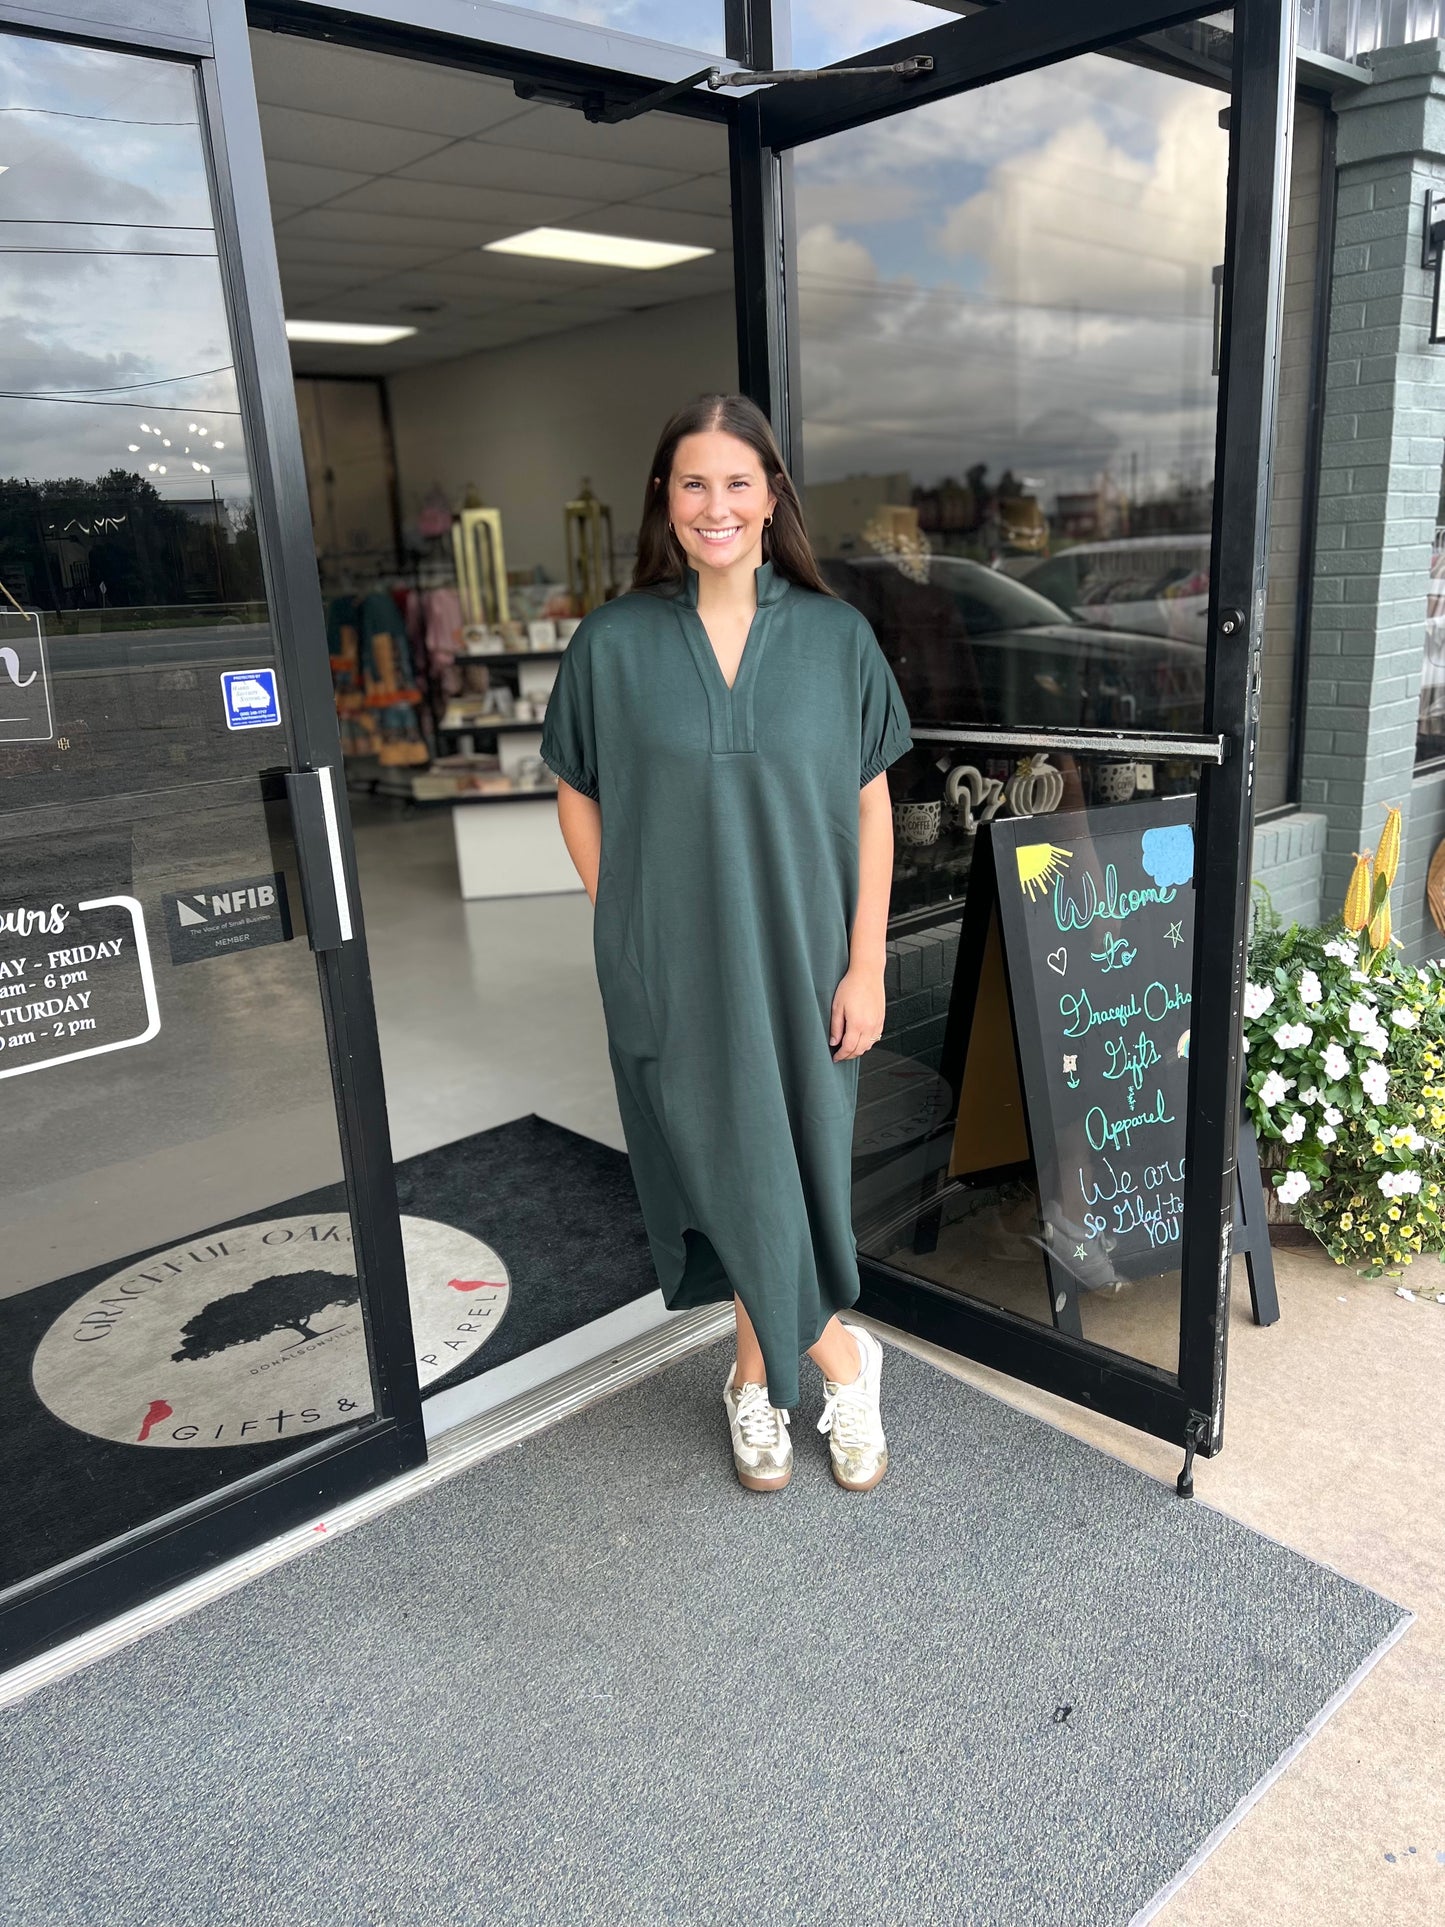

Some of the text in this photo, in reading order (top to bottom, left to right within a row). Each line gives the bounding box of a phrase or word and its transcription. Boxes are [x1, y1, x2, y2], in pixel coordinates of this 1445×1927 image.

[908, 820, 931, 830] COFFEE
[211, 885, 275, 916] NFIB
[1054, 864, 1177, 931] Welcome
[0, 903, 69, 936] urs
[190, 928, 202, 936] The
[203, 925, 220, 933] Voice
[228, 919, 245, 928] Small
[246, 913, 272, 924] Business
[48, 938, 123, 969] FRIDAY
[215, 933, 250, 947] MEMBER
[1090, 931, 1138, 973] to
[44, 974, 56, 989] 6
[60, 969, 88, 990] pm
[0, 991, 92, 1028] TURDAY
[1060, 981, 1192, 1038] Graceful Oaks
[8, 1031, 36, 1048] am
[53, 1022, 65, 1037] 2
[68, 1018, 96, 1036] pm
[1102, 1031, 1162, 1090] Gifts
[1085, 1089, 1176, 1151] Apparel
[1079, 1157, 1138, 1206] We
[1113, 1194, 1162, 1233] Glad
[1162, 1192, 1184, 1214] to
[1144, 1216, 1180, 1248] YOU
[73, 1225, 351, 1342] GRACEFUL OAK
[172, 1294, 497, 1441] GIFTS & PAREL
[249, 1325, 361, 1375] DONALSONVILLE
